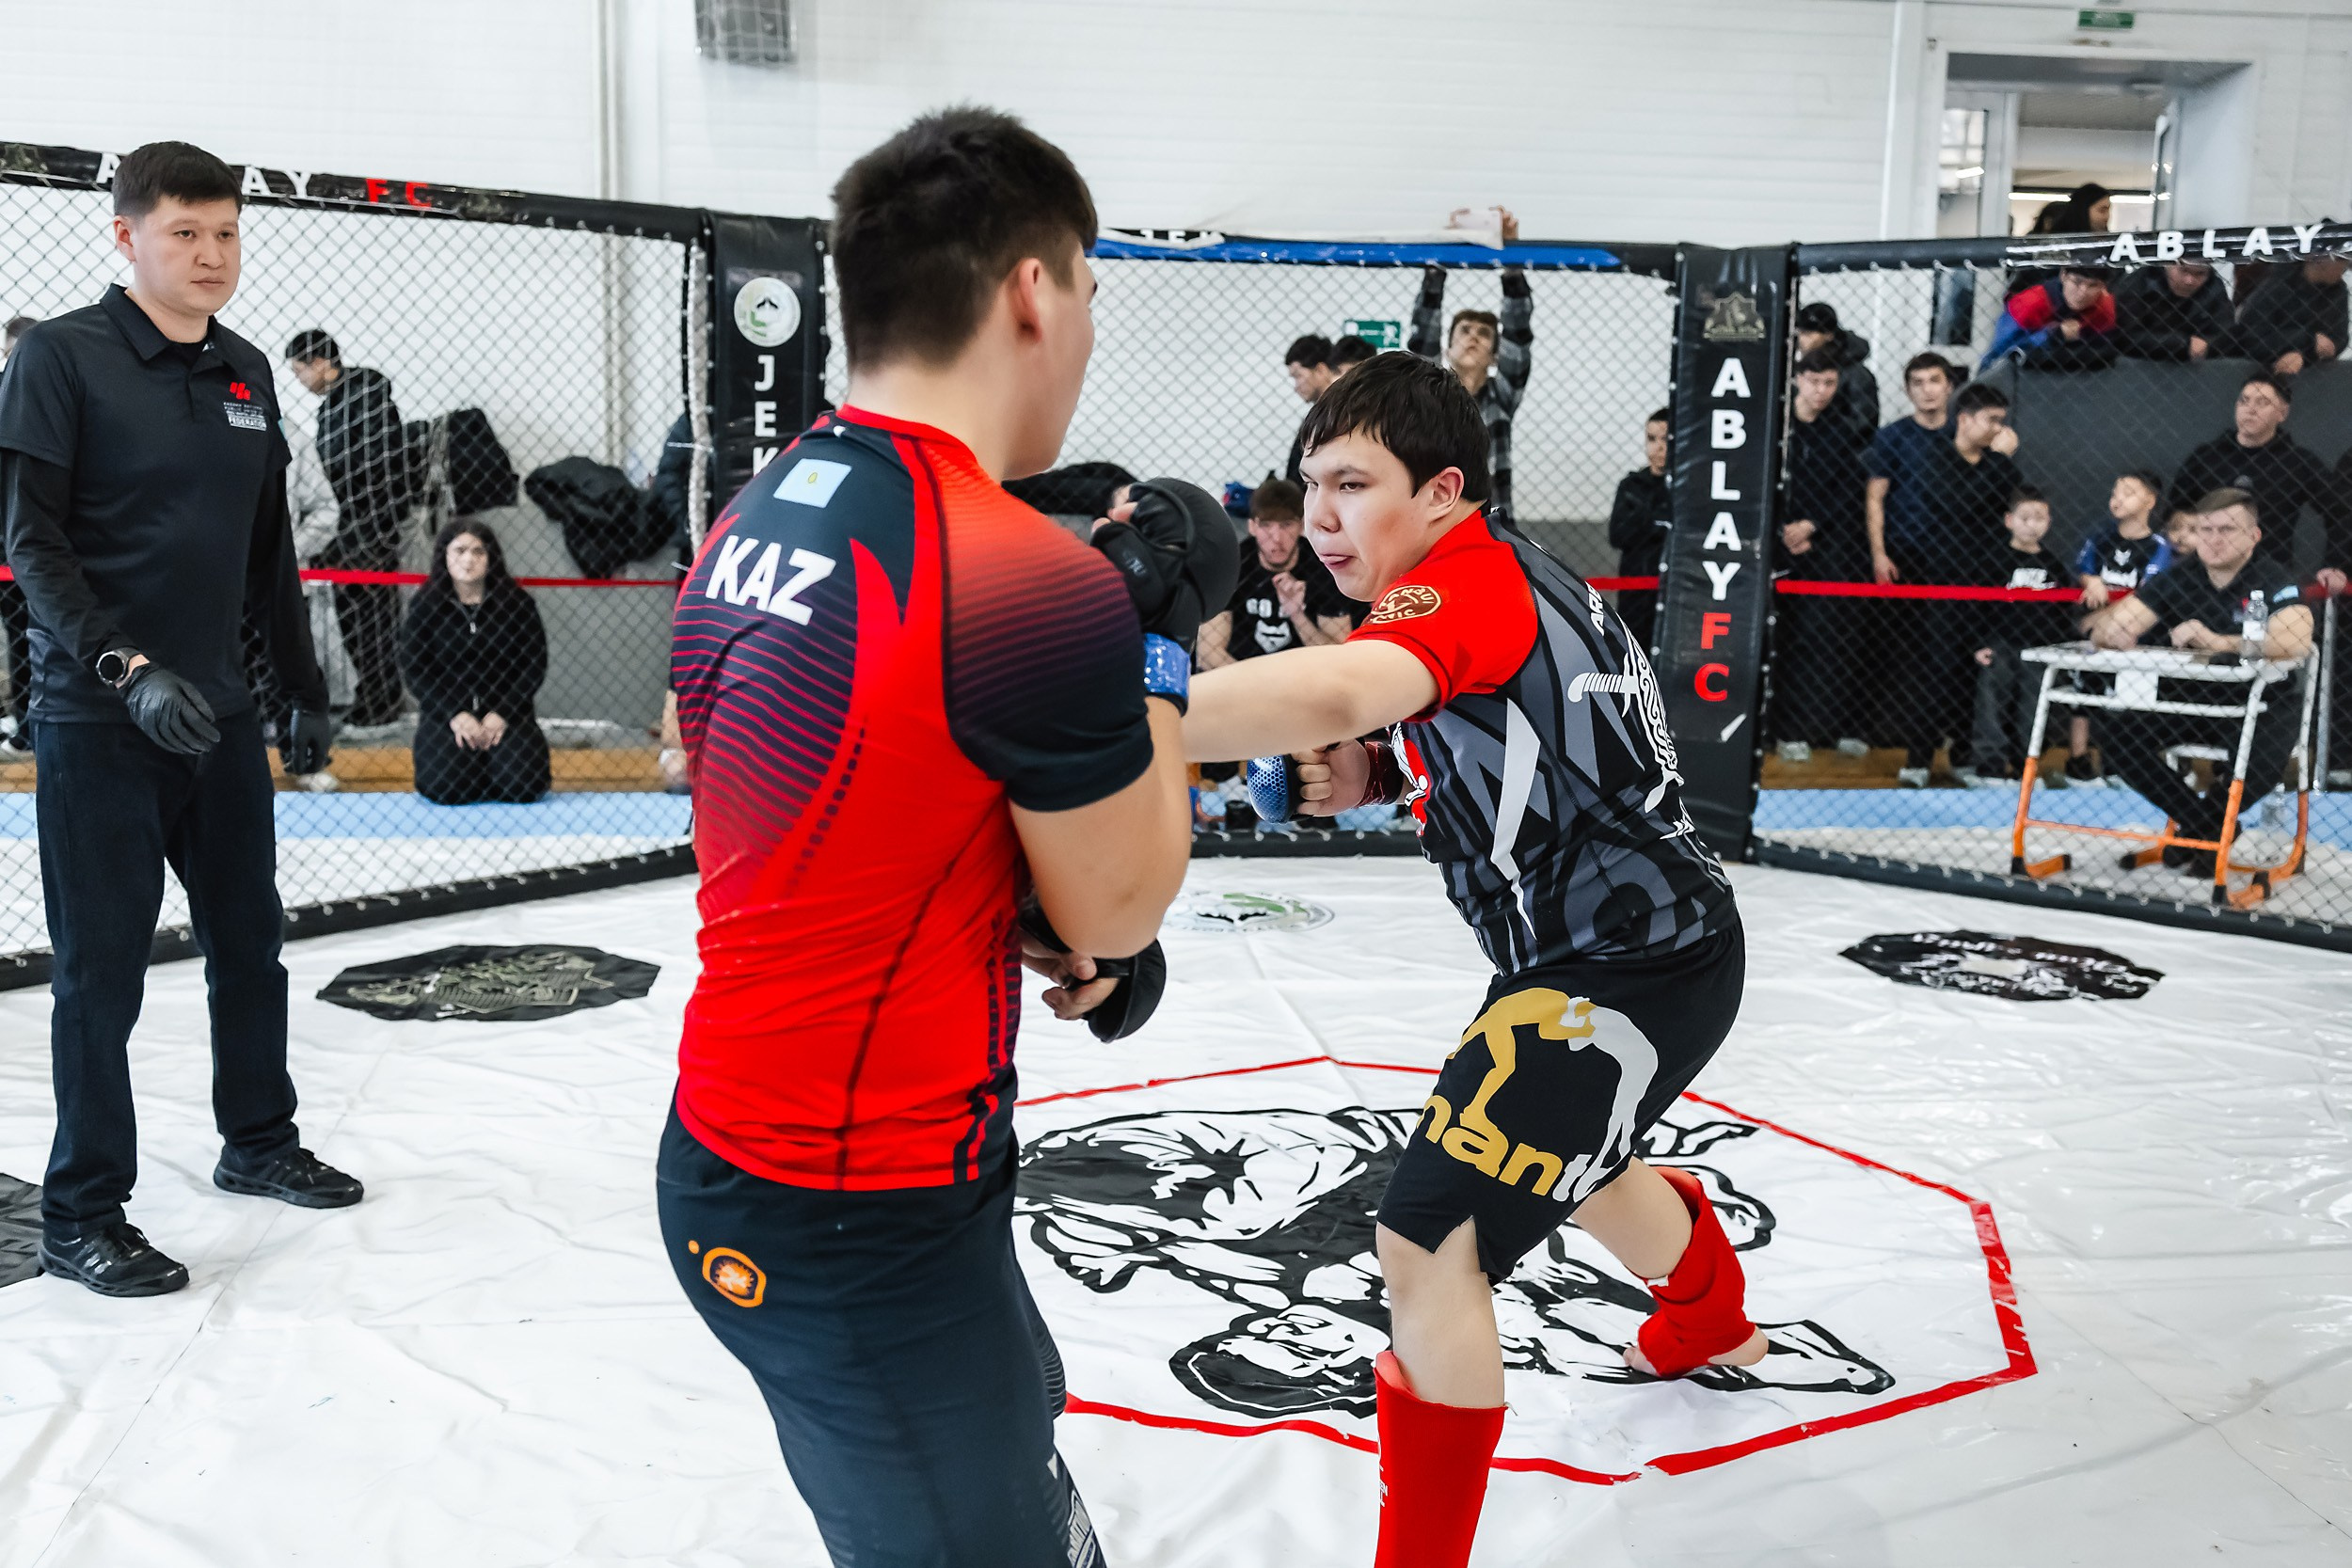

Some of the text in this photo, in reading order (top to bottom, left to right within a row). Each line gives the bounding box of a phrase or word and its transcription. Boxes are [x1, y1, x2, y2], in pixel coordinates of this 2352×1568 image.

[96, 152, 432, 208] AAY FC
[2109, 223, 2326, 263] ABLAY
[1703, 356, 1752, 601] ABLAY
[706, 534, 836, 626] KAZ
[1694, 612, 1732, 702] FC
